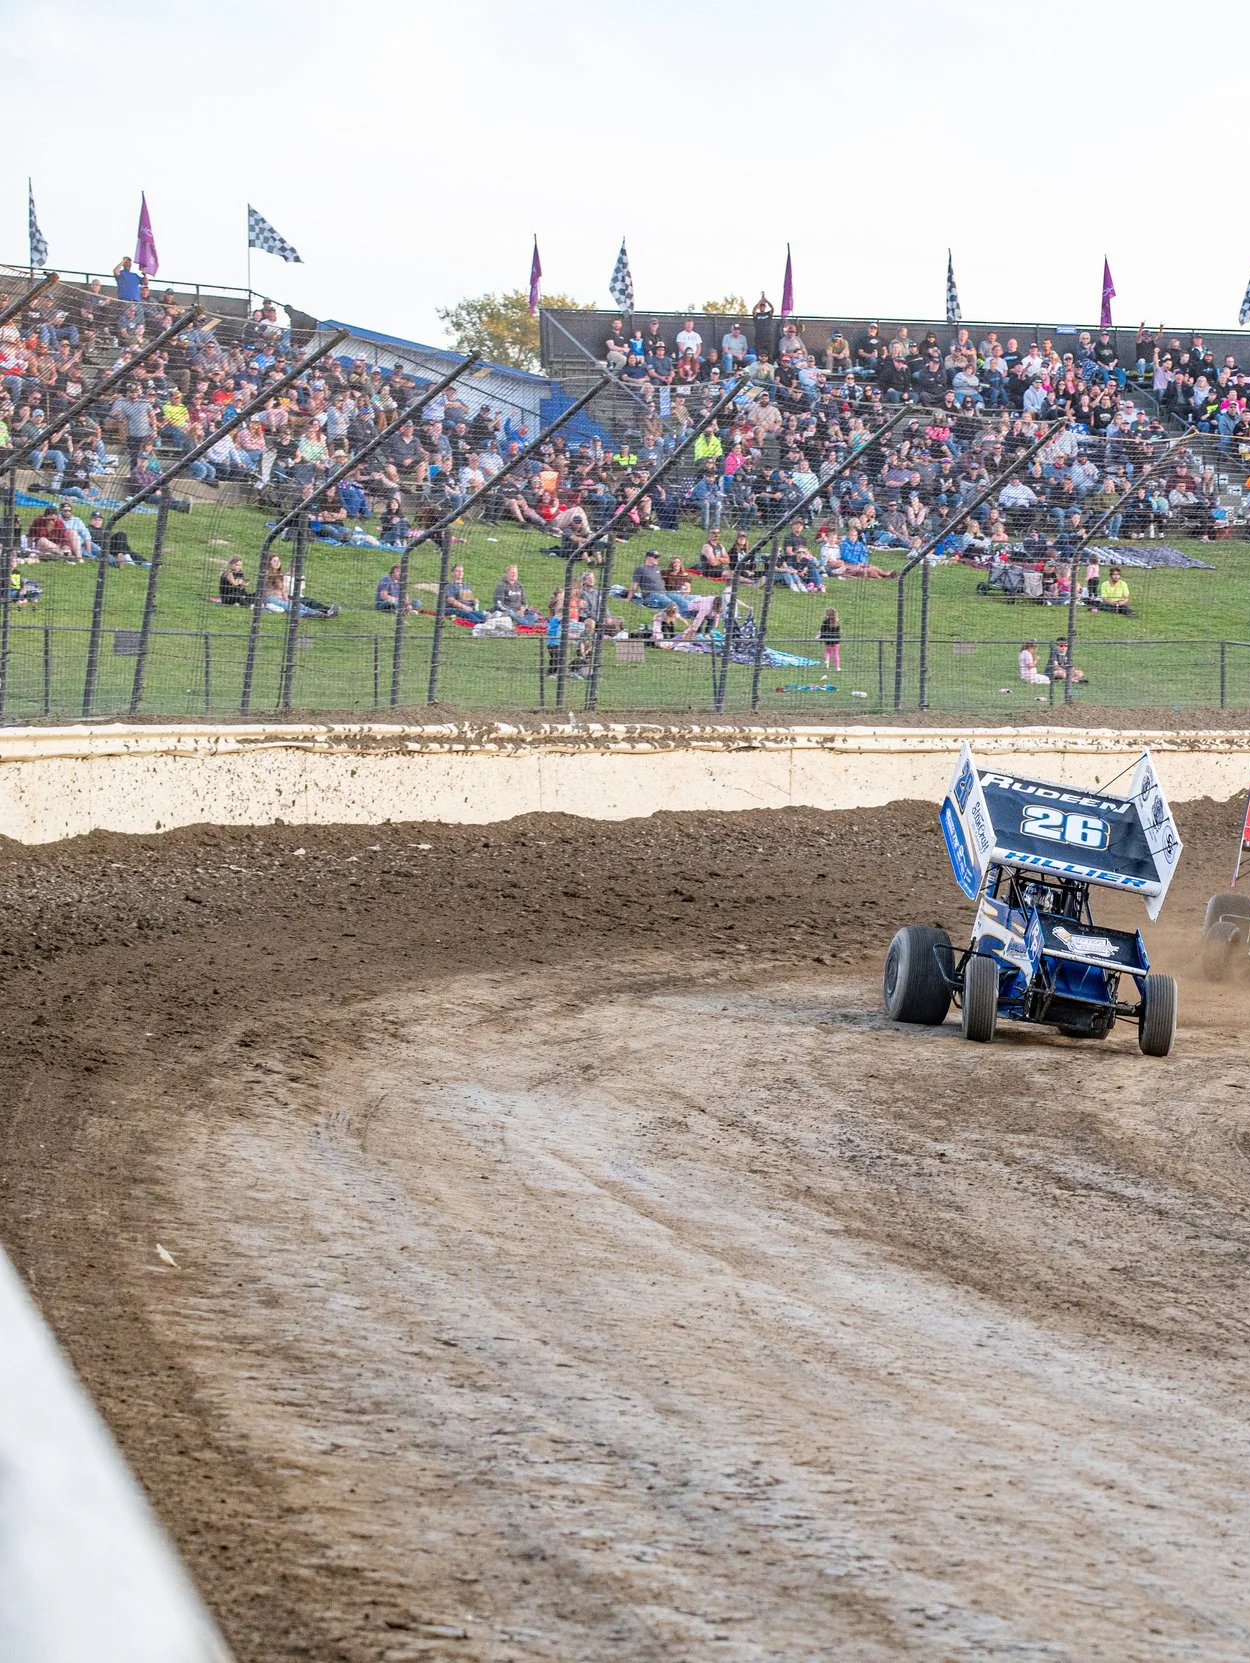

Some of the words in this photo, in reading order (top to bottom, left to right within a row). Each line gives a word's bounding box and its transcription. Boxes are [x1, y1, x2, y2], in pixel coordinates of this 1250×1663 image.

[980, 773, 1131, 814] RUDEEN
[1021, 805, 1110, 850] 26
[1004, 851, 1146, 888] HILLIER
